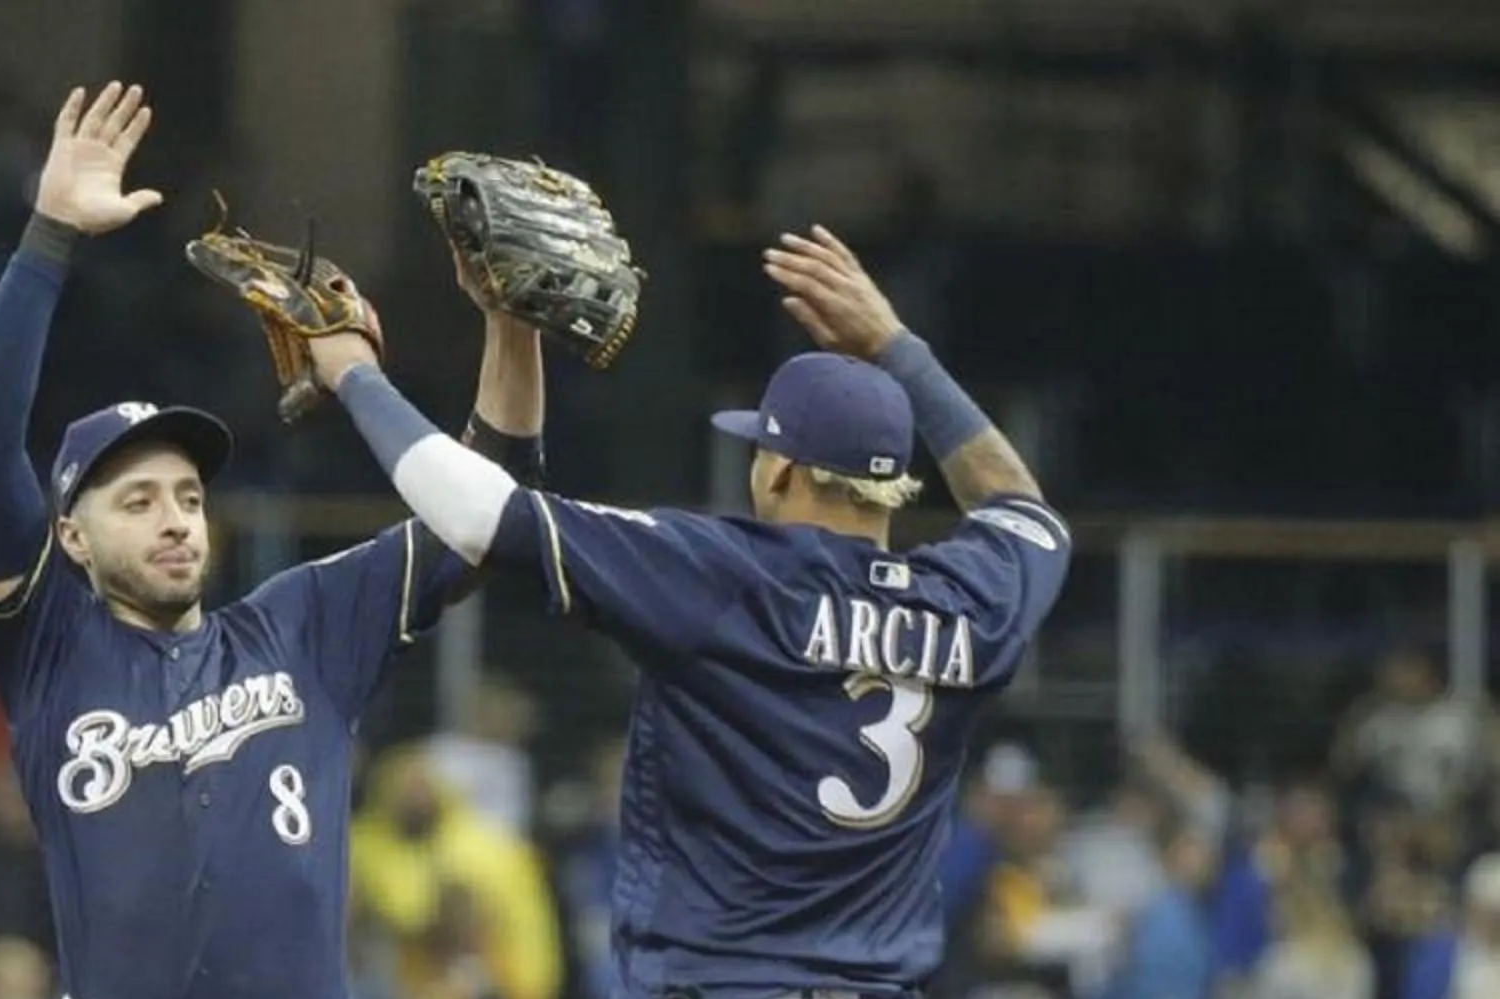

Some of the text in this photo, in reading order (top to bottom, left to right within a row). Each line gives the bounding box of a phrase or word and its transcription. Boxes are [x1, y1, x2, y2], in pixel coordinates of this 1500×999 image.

[803, 594, 975, 688] ARCIA
[57, 671, 305, 813] Brewers
[816, 672, 934, 830] 3
[269, 764, 311, 845] 8
